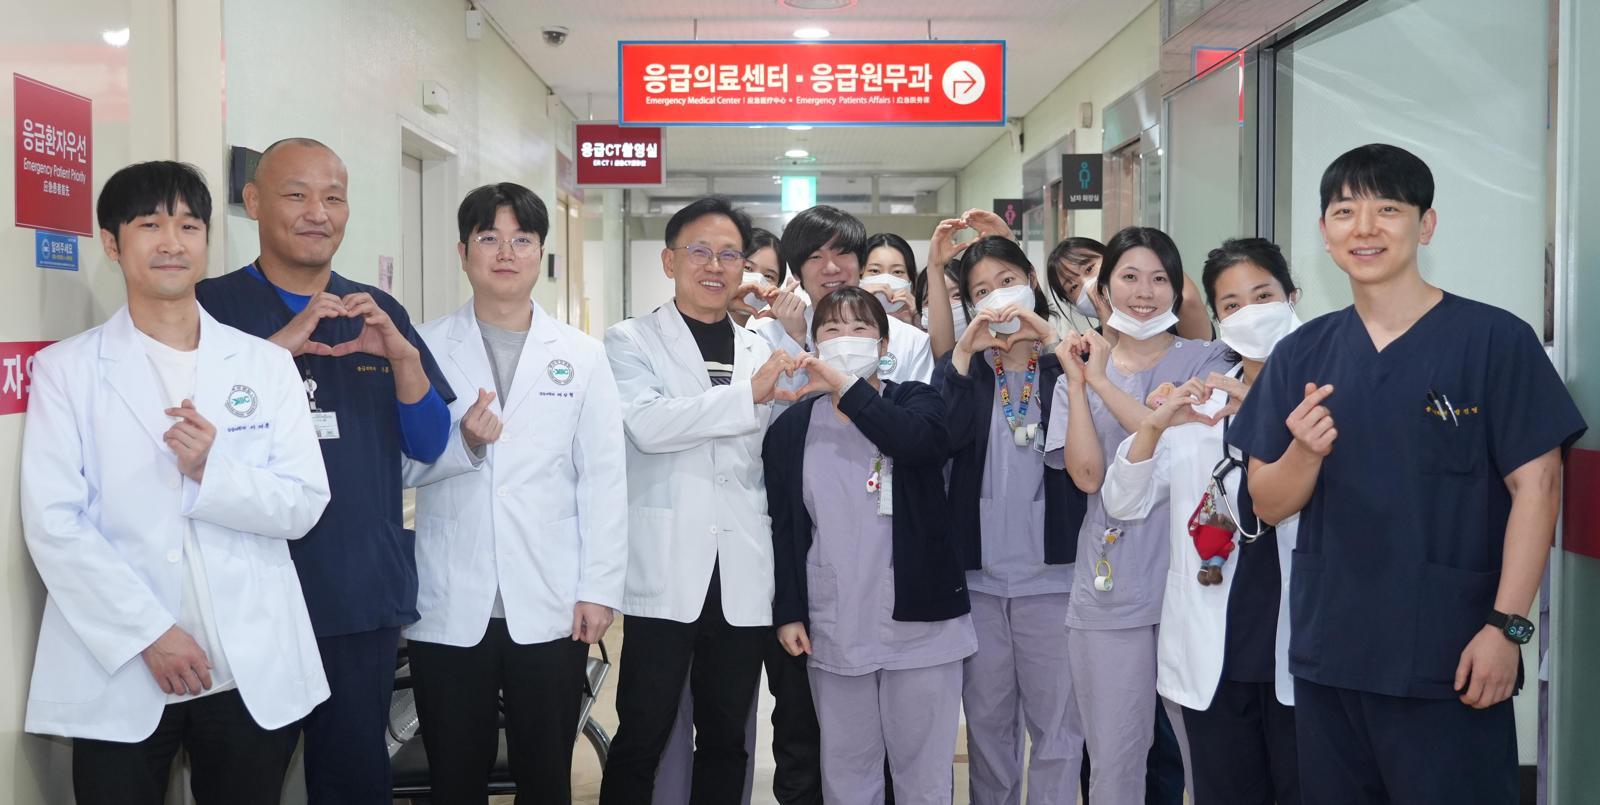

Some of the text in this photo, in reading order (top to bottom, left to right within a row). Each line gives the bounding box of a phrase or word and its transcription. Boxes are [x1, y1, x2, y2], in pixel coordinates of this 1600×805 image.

[643, 63, 932, 93] 응급의료센터 응급원무과
[646, 97, 686, 105] Emergency
[687, 96, 716, 105] Medical
[717, 97, 741, 105] Center
[796, 97, 836, 106] Emergency
[838, 96, 867, 105] Patients
[868, 96, 891, 105] Affairs
[23, 119, 86, 163] 응급환자우선
[24, 157, 86, 184] Emergency Patient Priority
